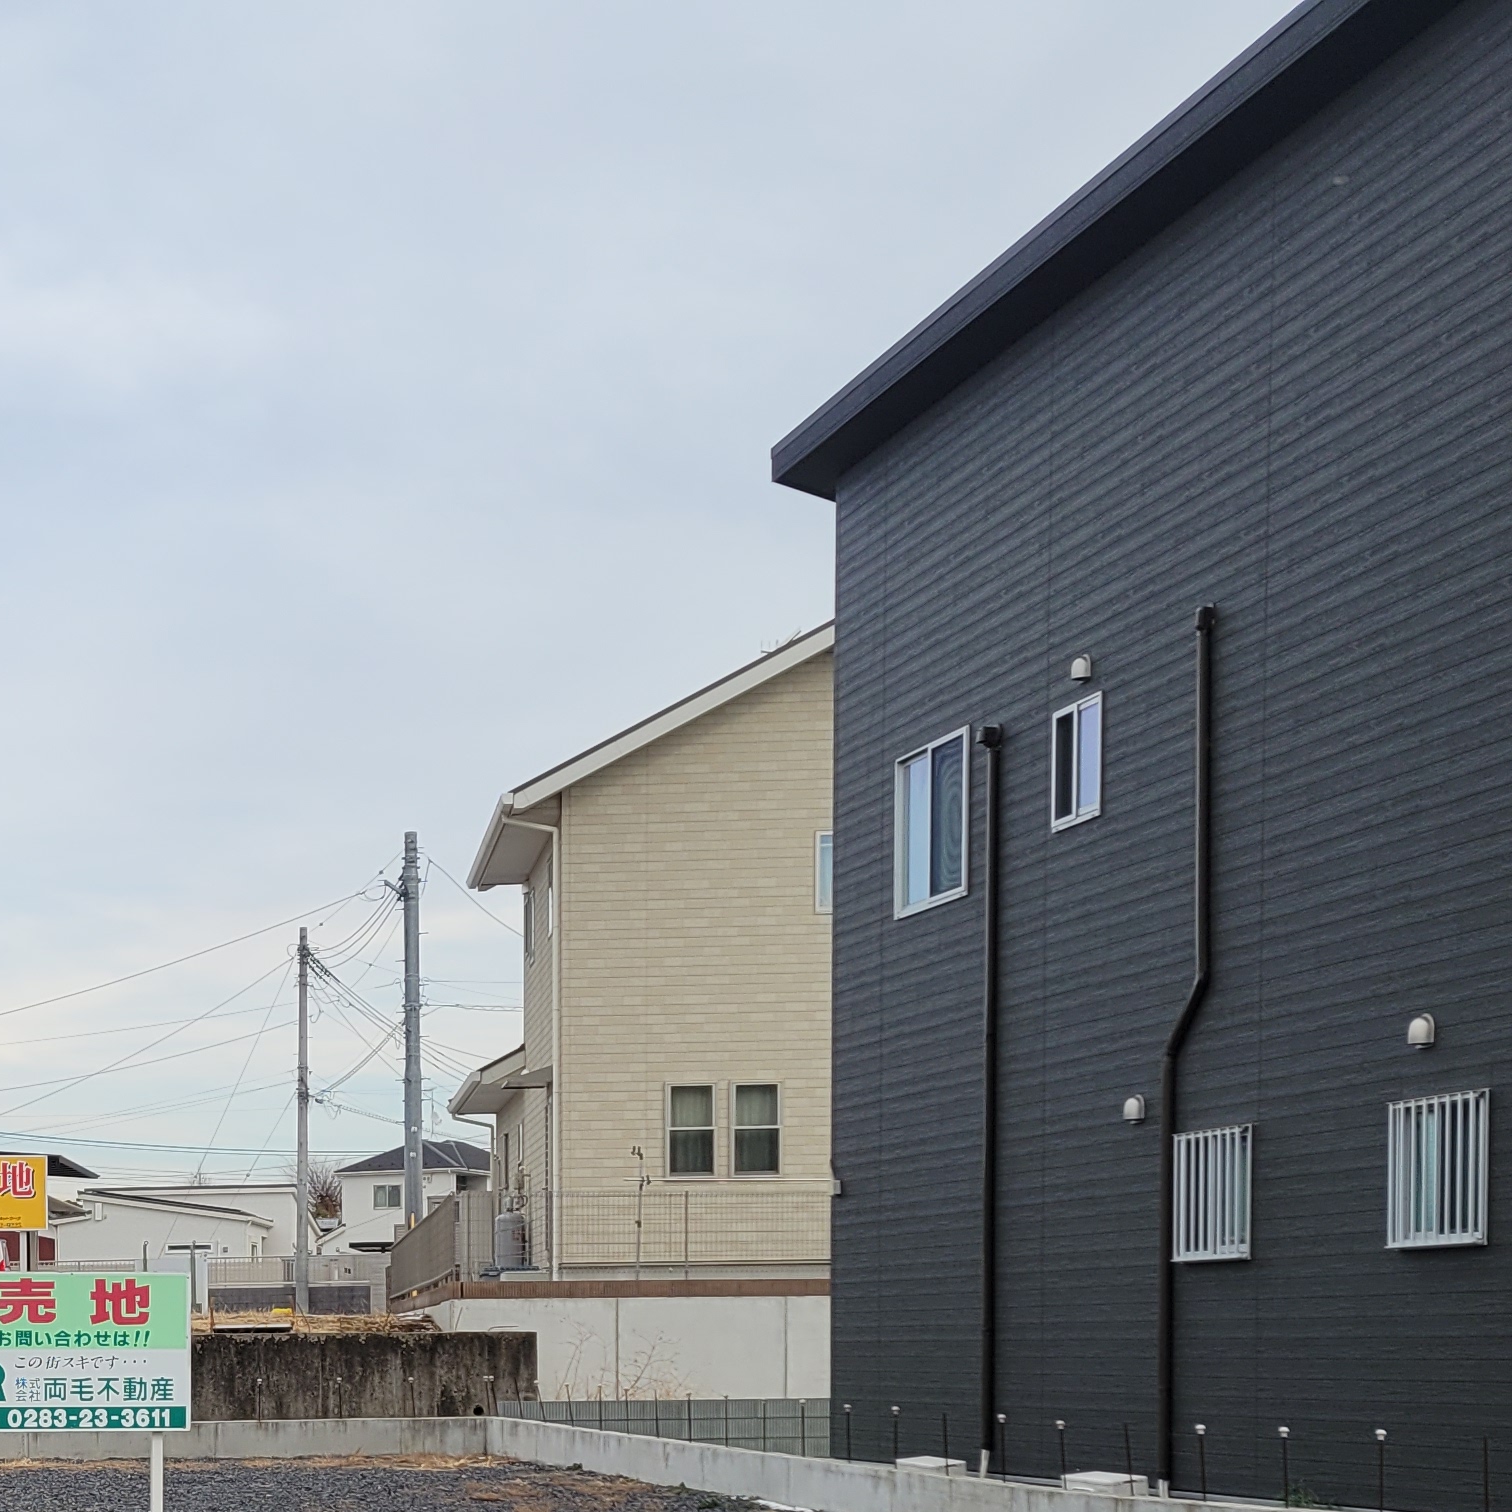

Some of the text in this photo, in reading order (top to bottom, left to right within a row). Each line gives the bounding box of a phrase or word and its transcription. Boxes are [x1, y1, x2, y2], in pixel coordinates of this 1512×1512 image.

[43, 1377, 175, 1402] 両毛不動産
[7, 1409, 171, 1428] 0283-23-3611
